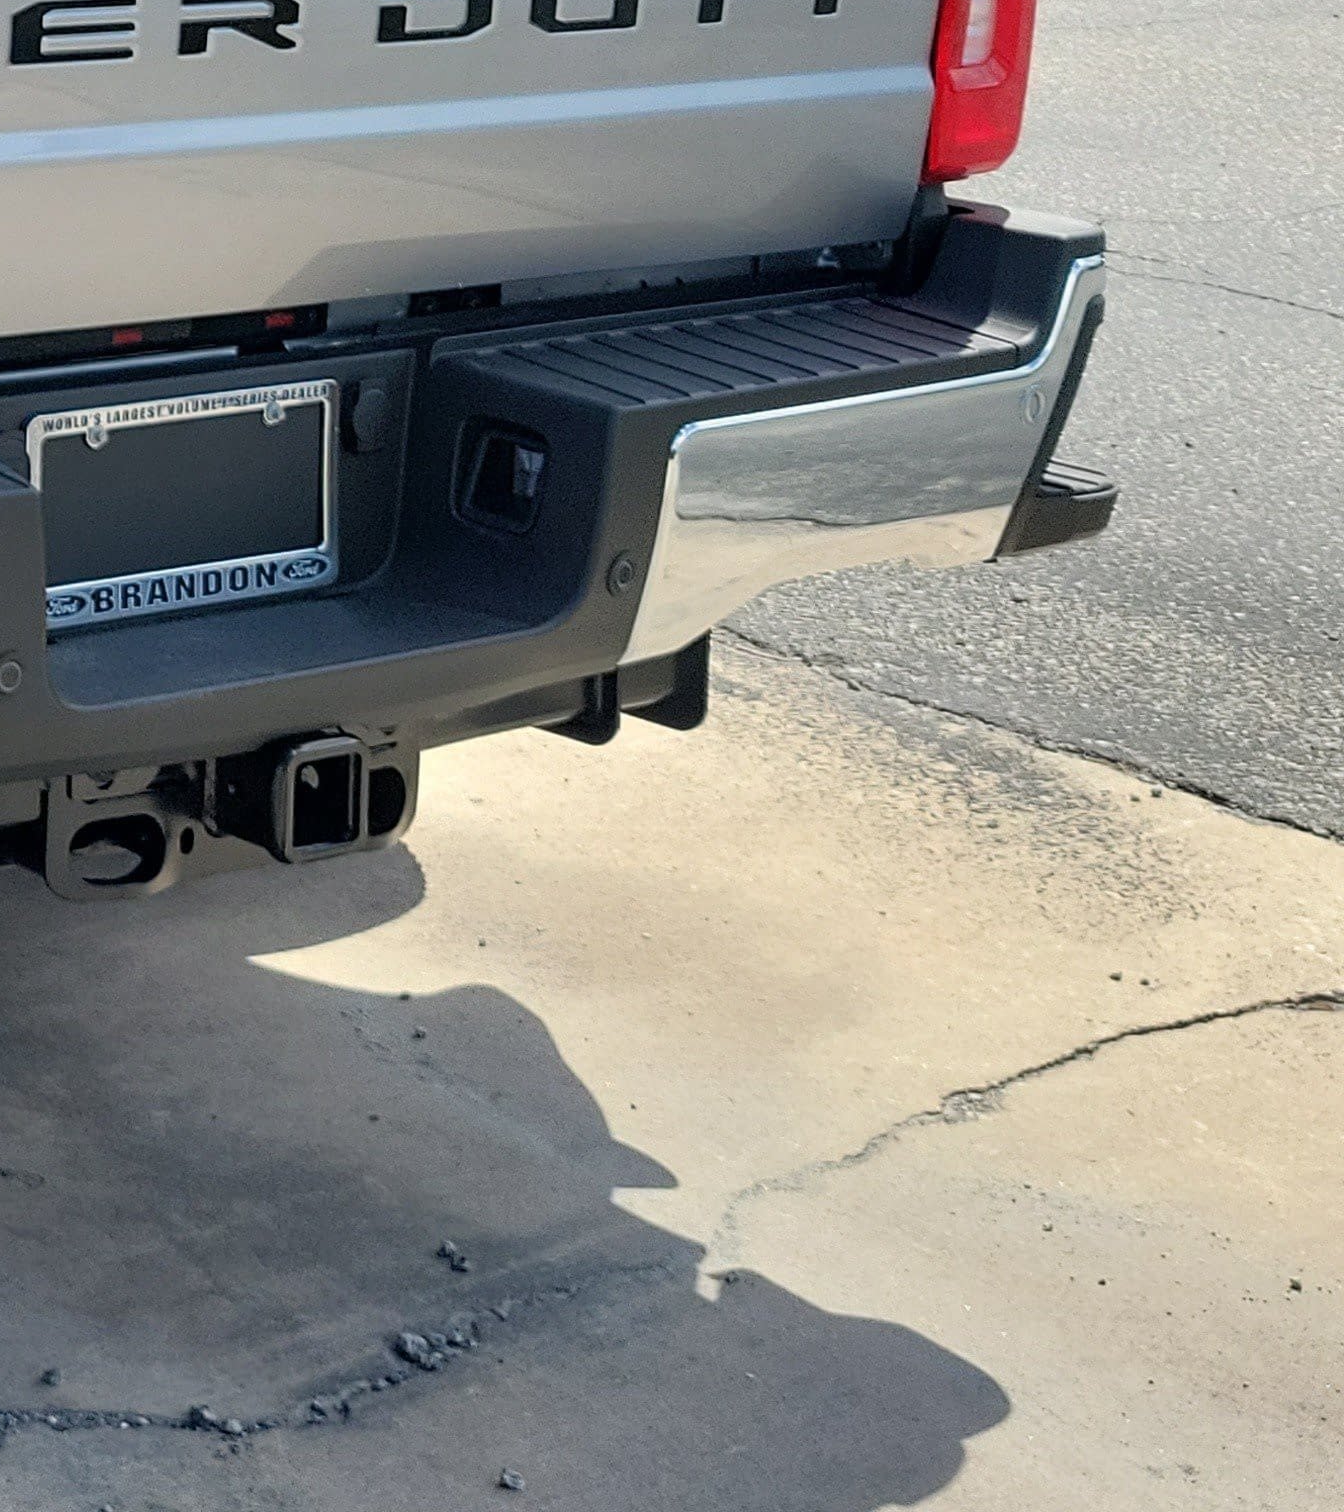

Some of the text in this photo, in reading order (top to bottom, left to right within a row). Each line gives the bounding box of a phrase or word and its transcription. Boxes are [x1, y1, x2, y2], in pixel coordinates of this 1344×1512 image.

[43, 412, 102, 432] WORLD'S
[107, 404, 163, 424] LARGEST
[167, 397, 217, 416] VOLUME
[281, 385, 328, 401] DEALER
[91, 561, 277, 614] BRANDON
